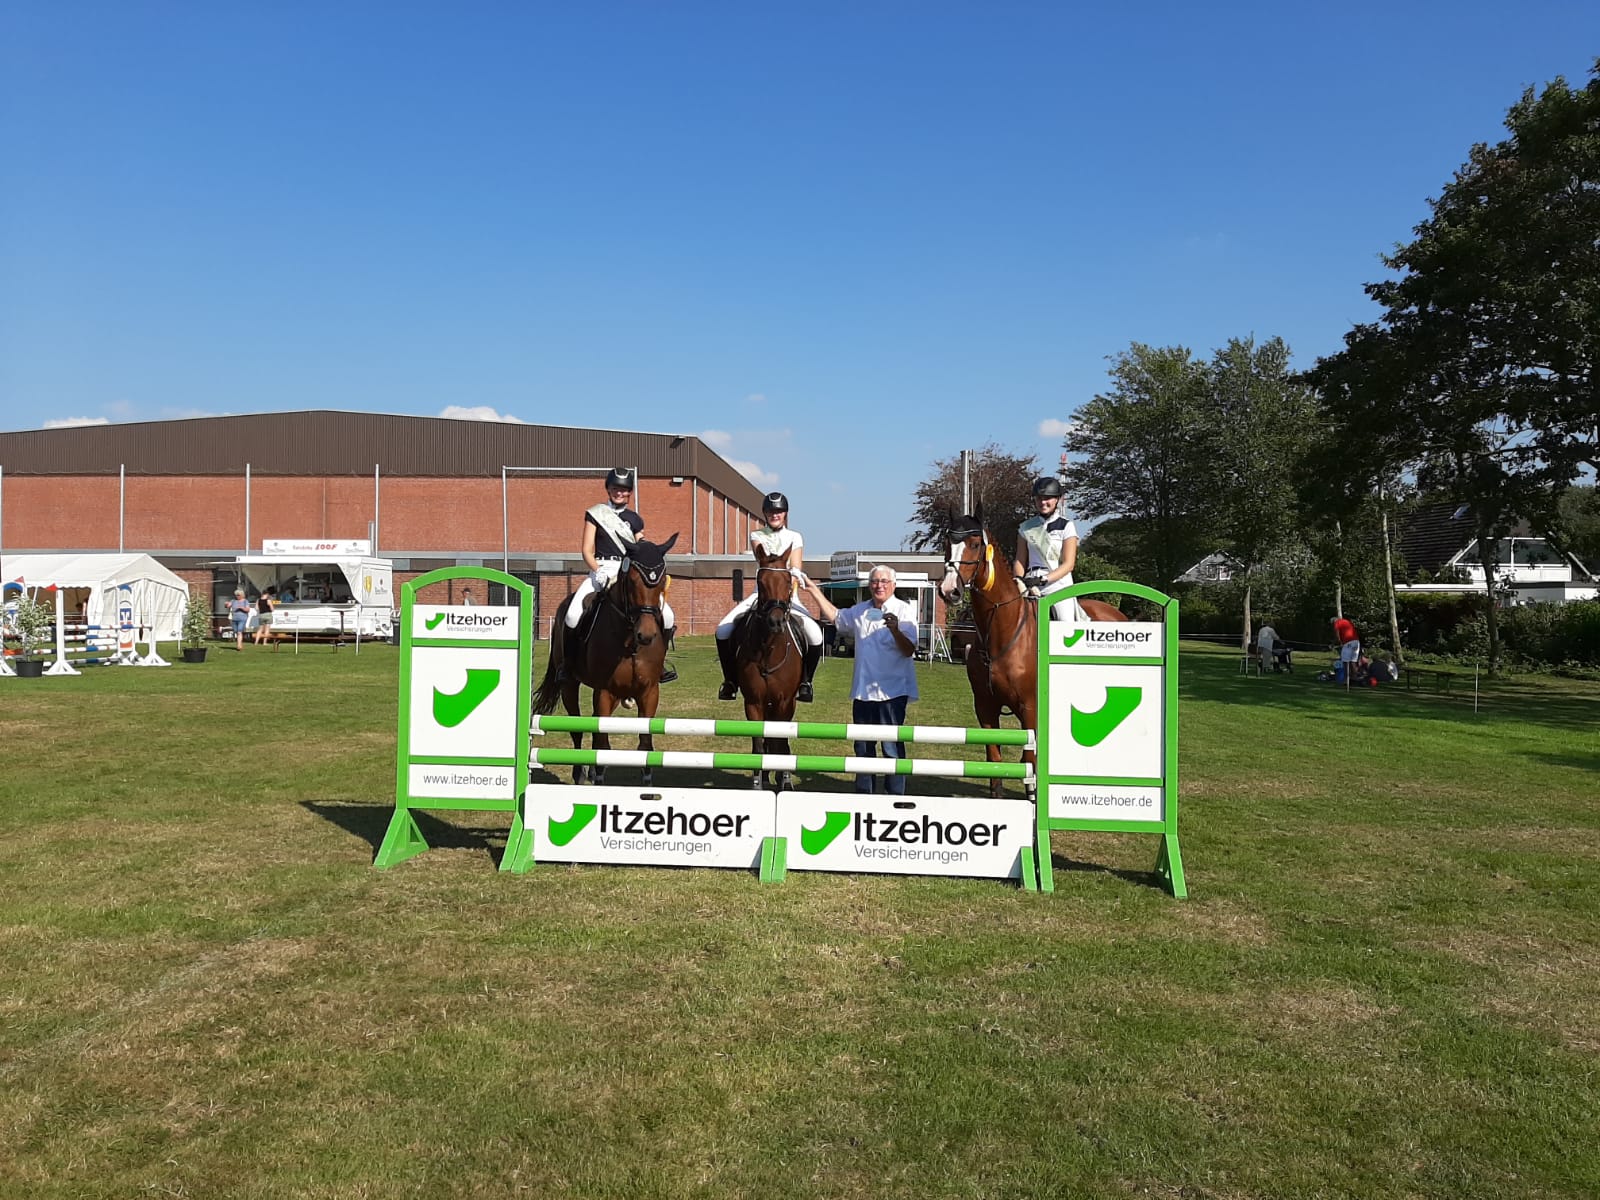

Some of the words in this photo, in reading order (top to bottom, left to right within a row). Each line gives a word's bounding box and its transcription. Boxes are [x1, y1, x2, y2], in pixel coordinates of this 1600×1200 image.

[446, 613, 508, 627] Itzehoer
[1085, 629, 1153, 642] Itzehoer
[423, 774, 509, 787] www.itzehoer.de
[1061, 794, 1153, 807] www.itzehoer.de
[600, 804, 750, 837] Itzehoer
[854, 812, 1007, 846] Itzehoer
[600, 836, 713, 856] Versicherungen
[855, 845, 969, 865] Versicherungen
